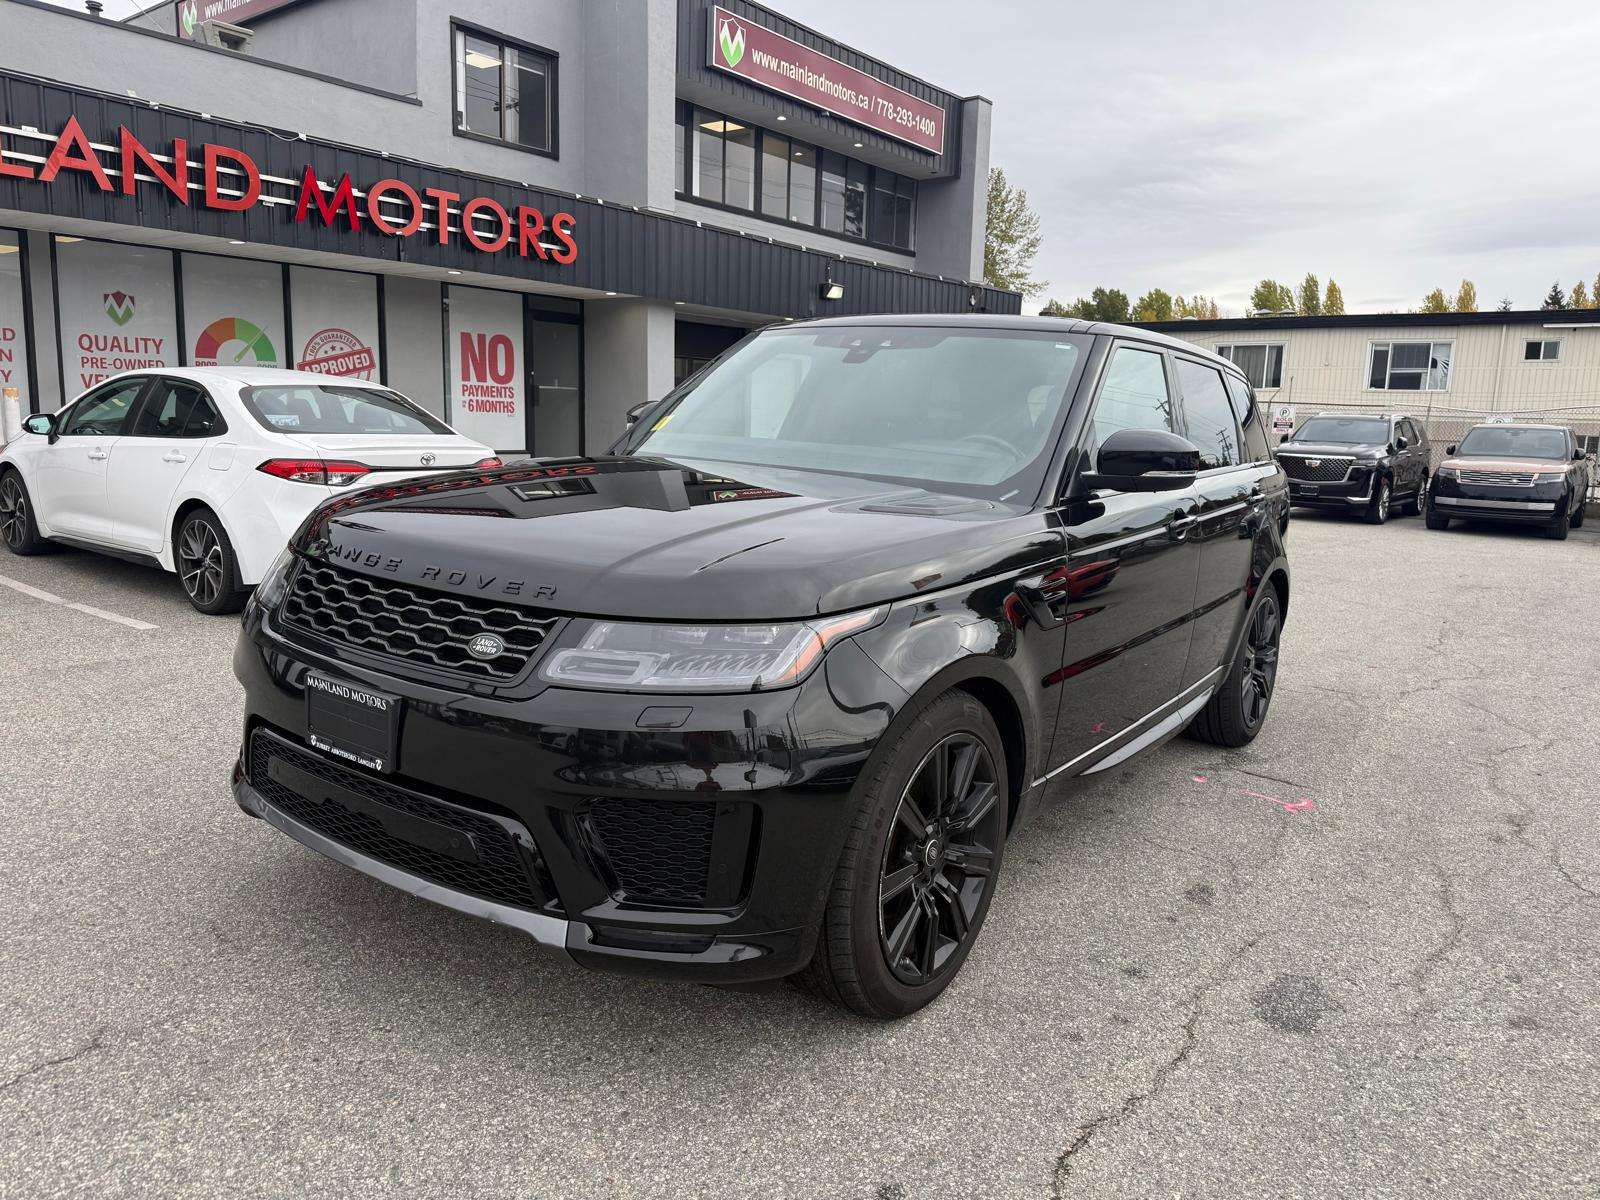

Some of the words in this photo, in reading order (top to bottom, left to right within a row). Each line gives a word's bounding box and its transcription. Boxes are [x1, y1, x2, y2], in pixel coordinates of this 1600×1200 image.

[752, 48, 869, 109] www.mainlandmotors.ca
[870, 95, 875, 112] /
[877, 98, 936, 137] 778-293-1400
[295, 163, 578, 265] MOTORS
[78, 333, 163, 355] QUALITY
[81, 356, 166, 370] PRE-OWNED
[304, 353, 370, 375] APPROVED
[460, 331, 515, 385] NO
[461, 384, 515, 399] PAYMENTS
[468, 399, 475, 412] 6
[476, 399, 515, 414] MONTHS
[317, 538, 404, 573] RANGE
[421, 566, 557, 600] ROVER
[475, 645, 497, 654] ROVER
[476, 638, 494, 647] LAND
[307, 676, 350, 698] MAINLAND
[351, 690, 387, 711] MOTORS
